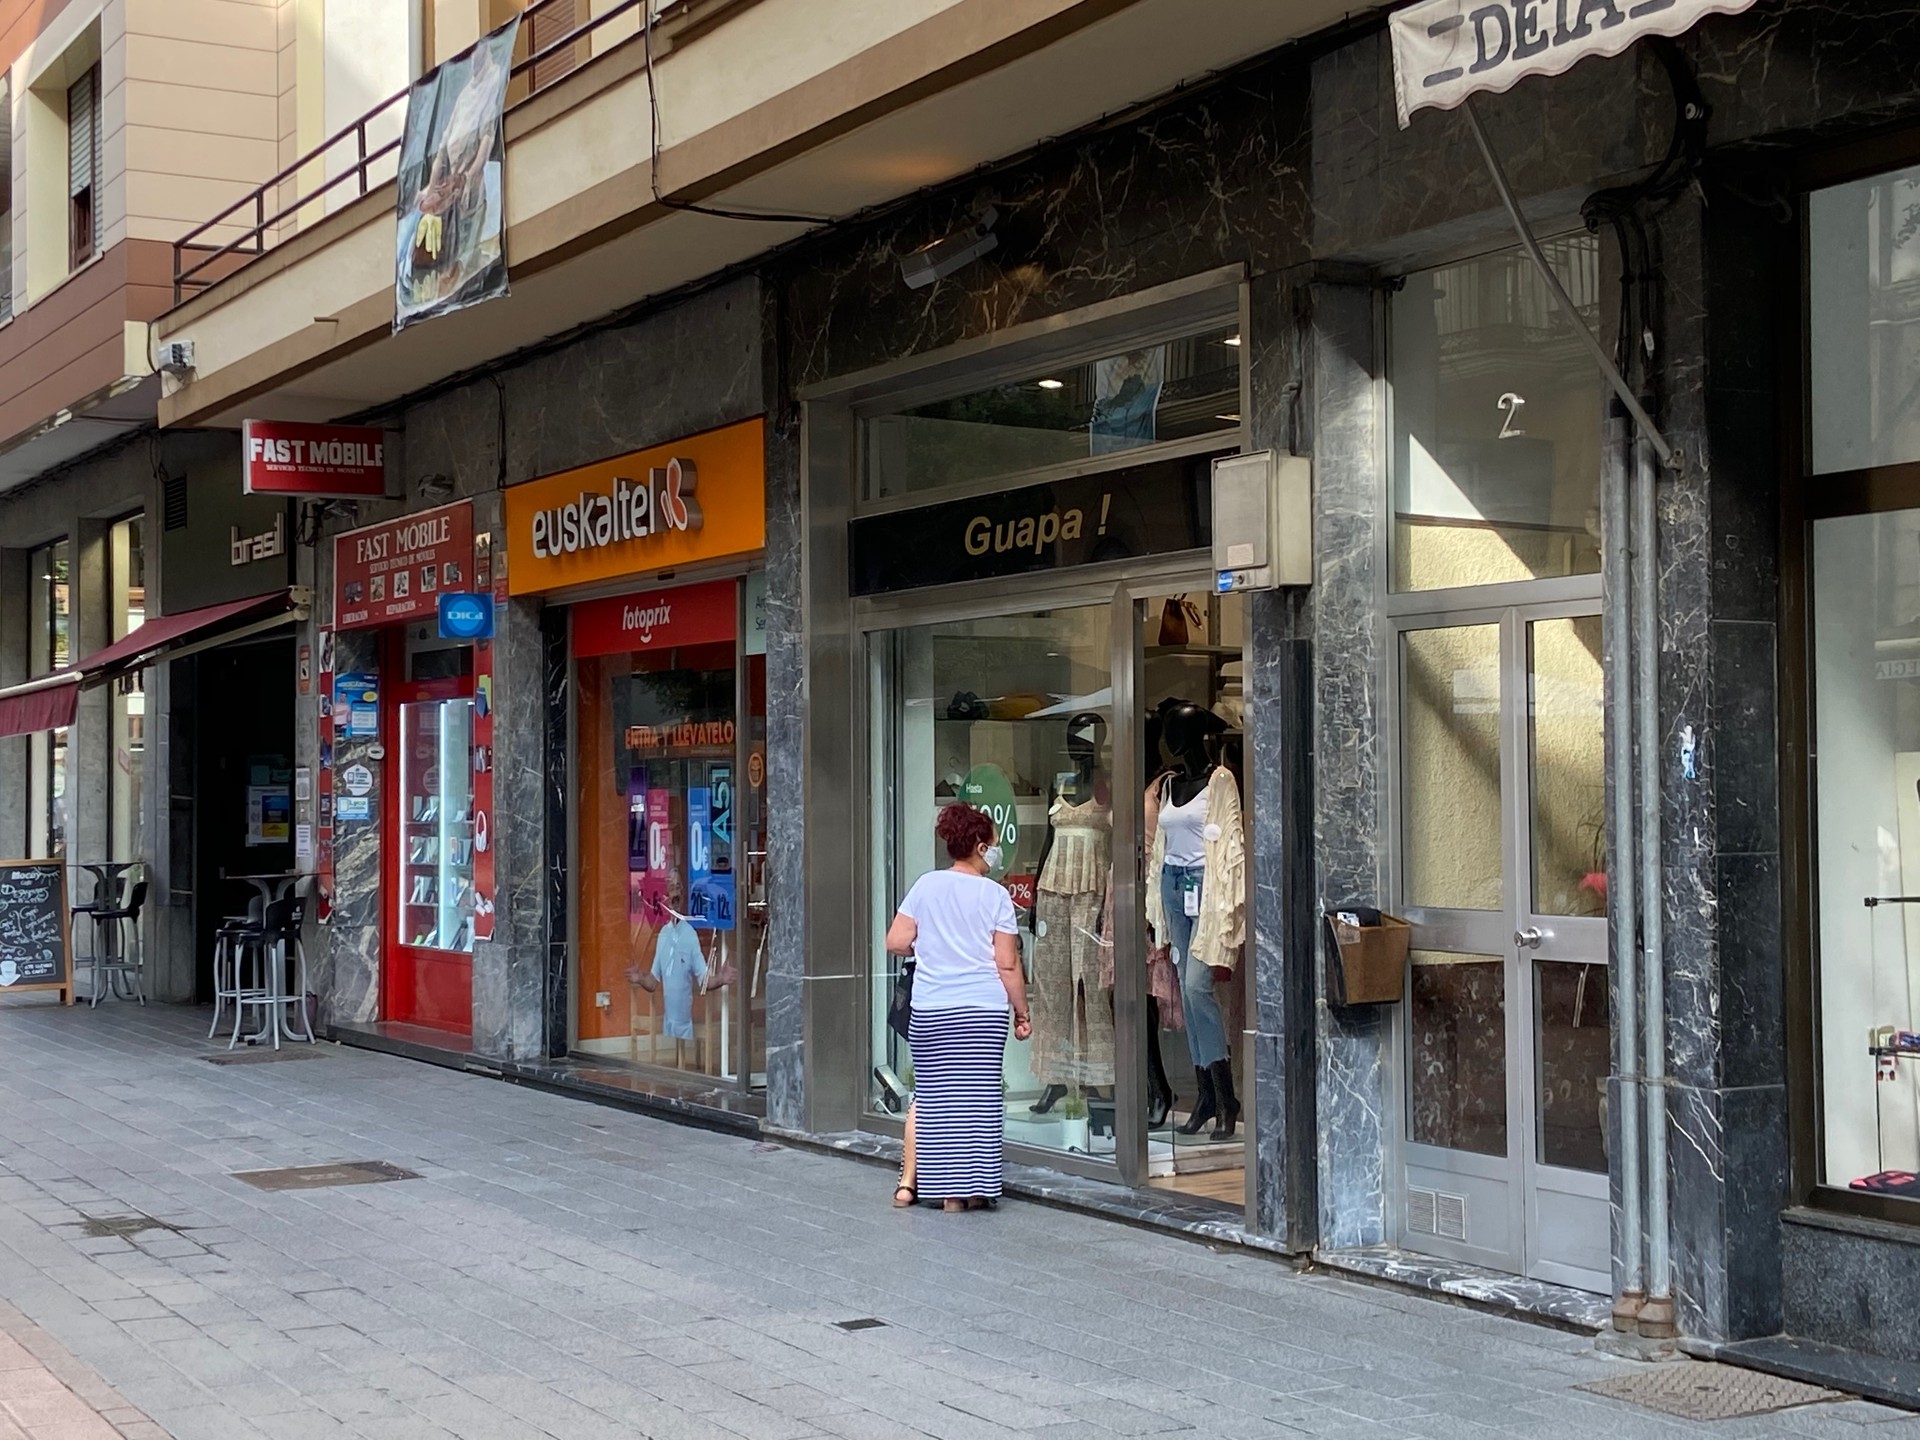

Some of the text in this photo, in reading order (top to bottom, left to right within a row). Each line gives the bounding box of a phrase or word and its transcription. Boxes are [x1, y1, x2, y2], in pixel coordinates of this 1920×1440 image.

[1497, 392, 1525, 439] 2
[251, 437, 383, 467] FAST MÓBILE
[532, 467, 655, 559] euskaltel
[965, 493, 1111, 556] Guapa !
[231, 512, 284, 566] brasil
[357, 532, 390, 564] FAST
[622, 598, 672, 634] fotoprix
[625, 727, 659, 749] ENTRA
[966, 784, 983, 794] Hasta
